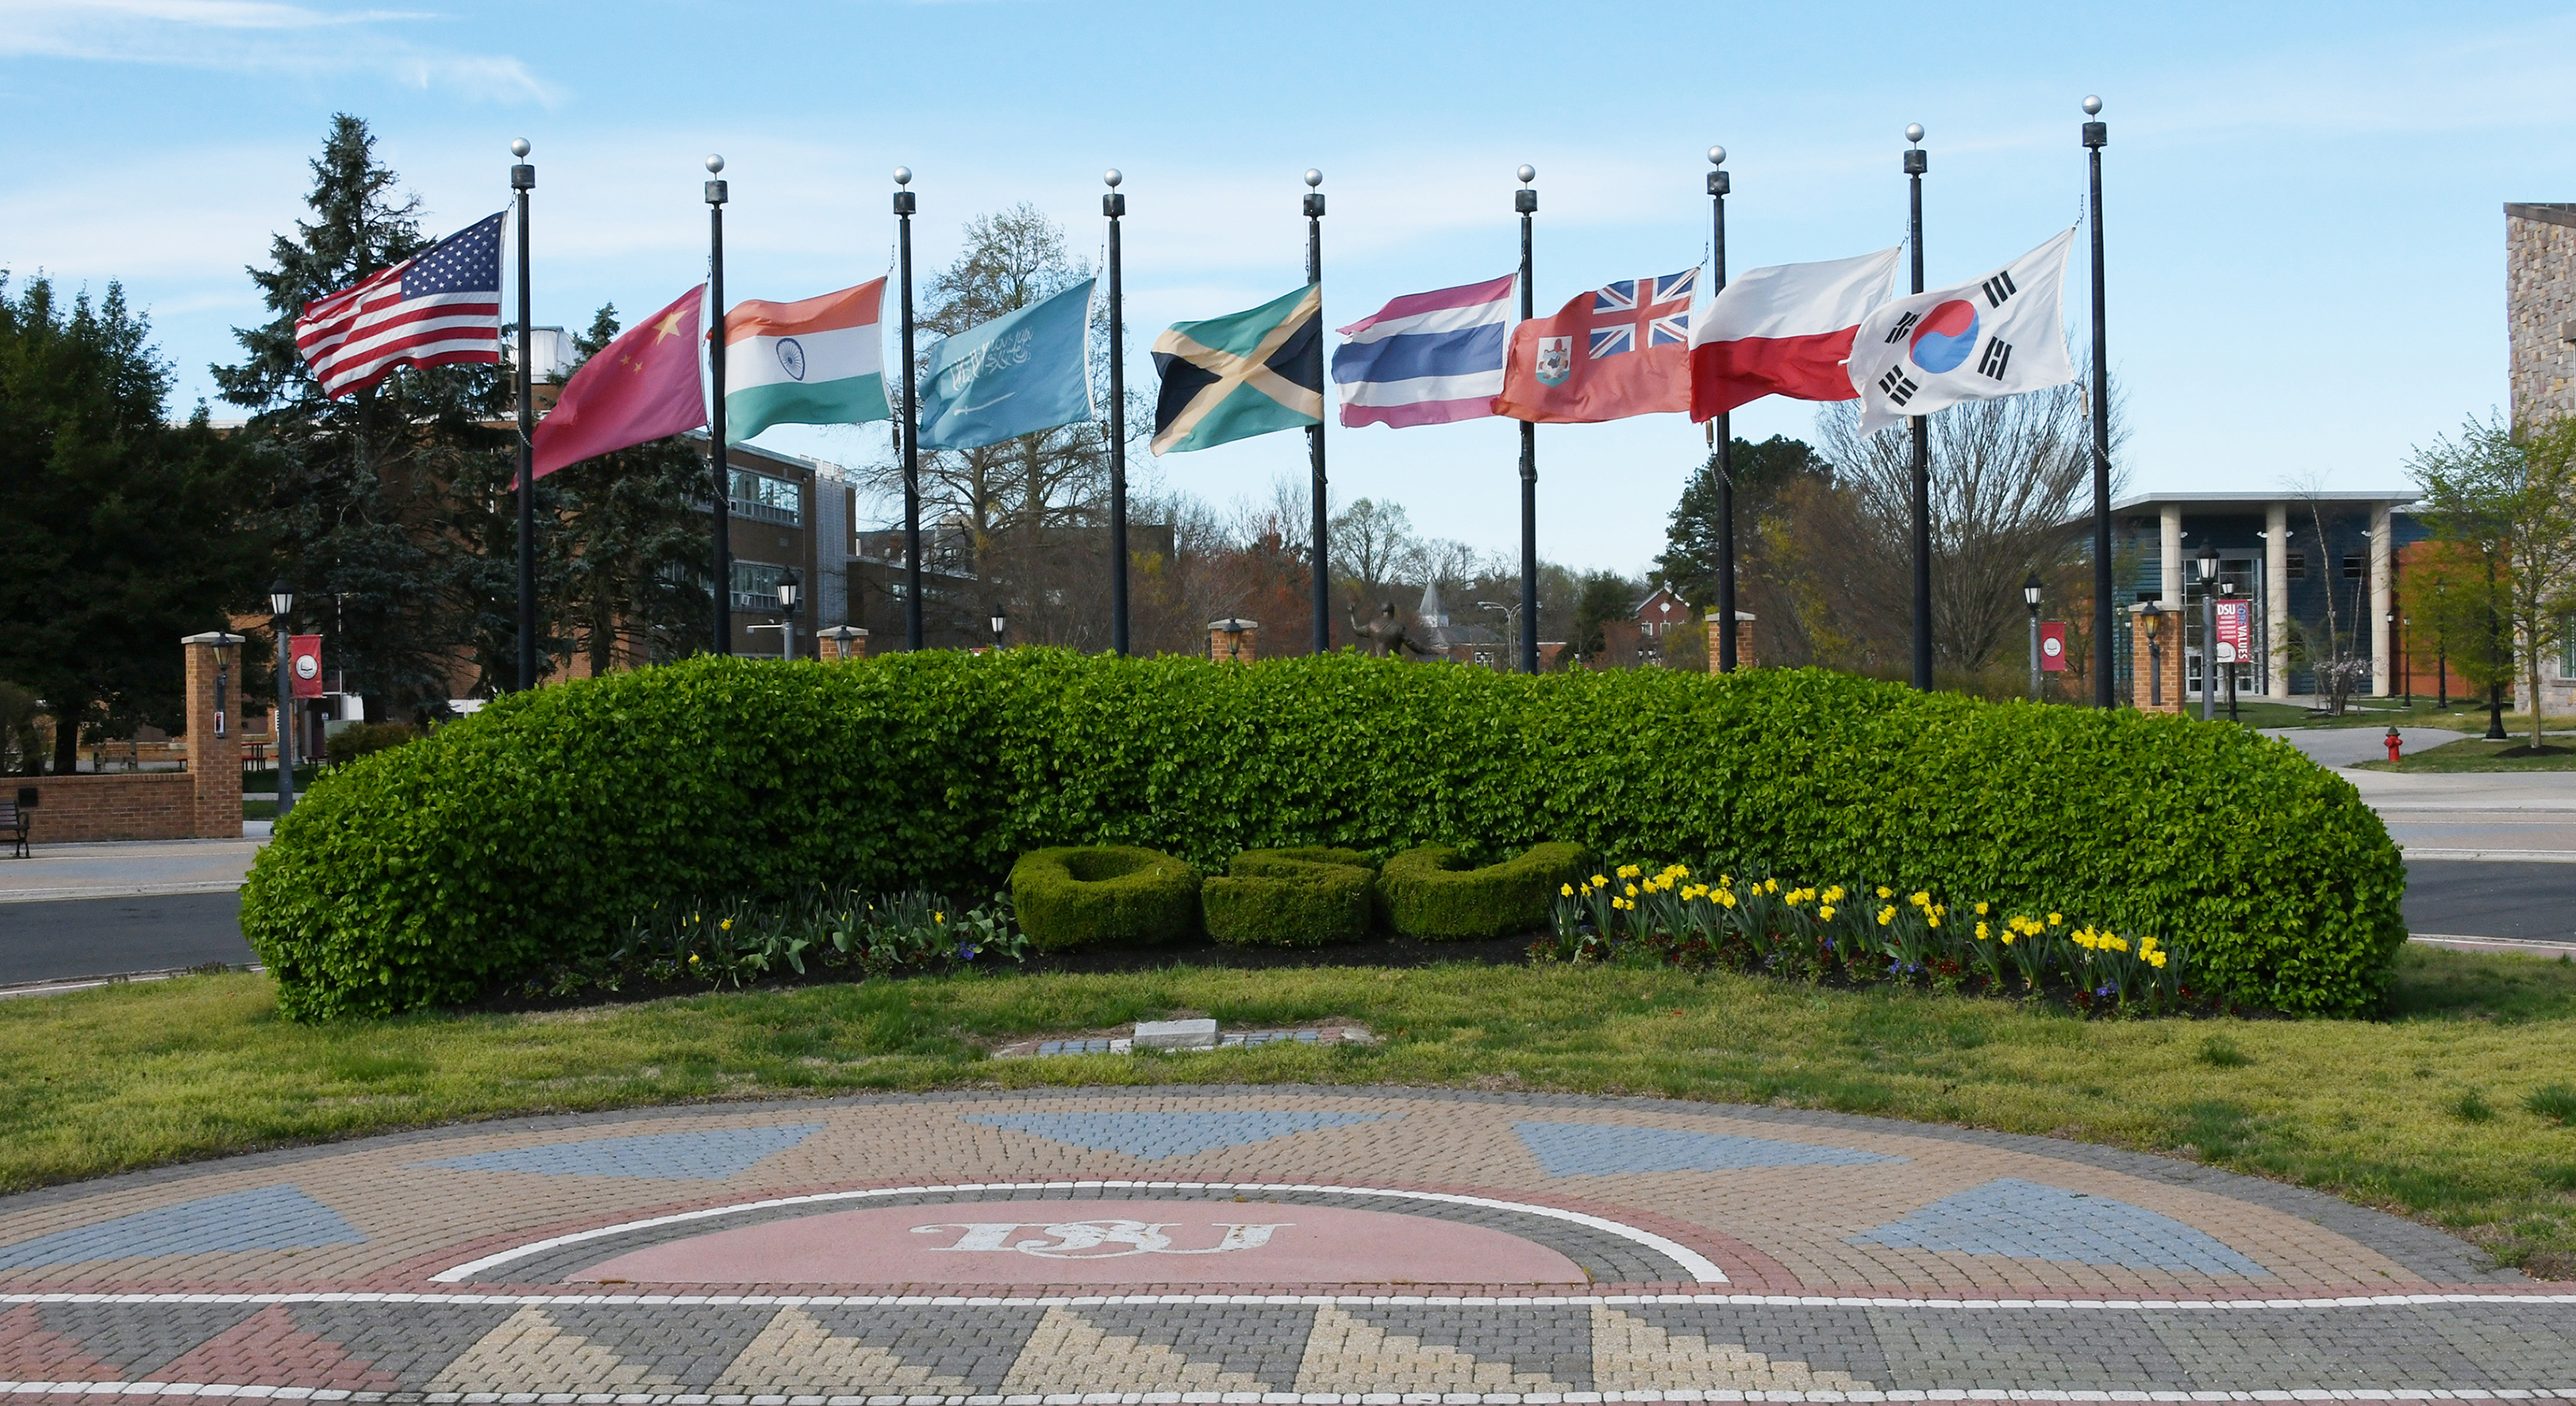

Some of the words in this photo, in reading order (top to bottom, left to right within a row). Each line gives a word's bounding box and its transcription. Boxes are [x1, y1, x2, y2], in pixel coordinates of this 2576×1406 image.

[2217, 604, 2236, 615] DSU
[2237, 603, 2247, 625] CORE
[2237, 625, 2247, 659] VALUES
